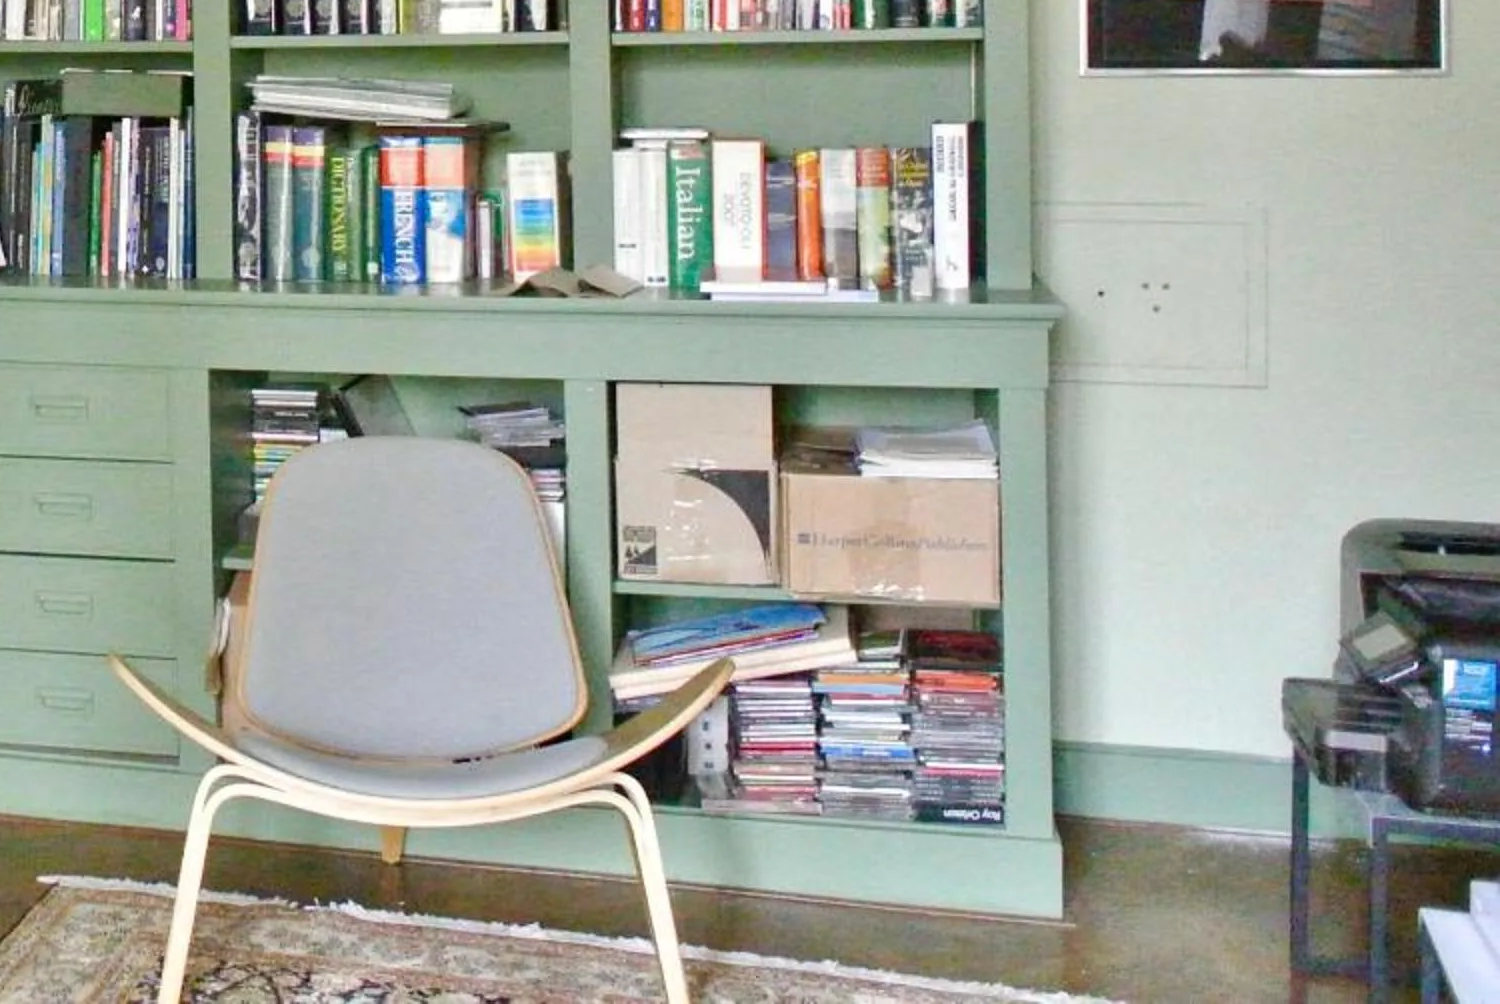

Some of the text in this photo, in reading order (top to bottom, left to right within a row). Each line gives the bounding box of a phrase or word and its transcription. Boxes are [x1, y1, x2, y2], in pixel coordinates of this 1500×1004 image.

[331, 157, 348, 252] DICTIONARY
[394, 190, 416, 265] FRENCH
[676, 166, 703, 260] Italian
[982, 807, 1001, 821] Roy
